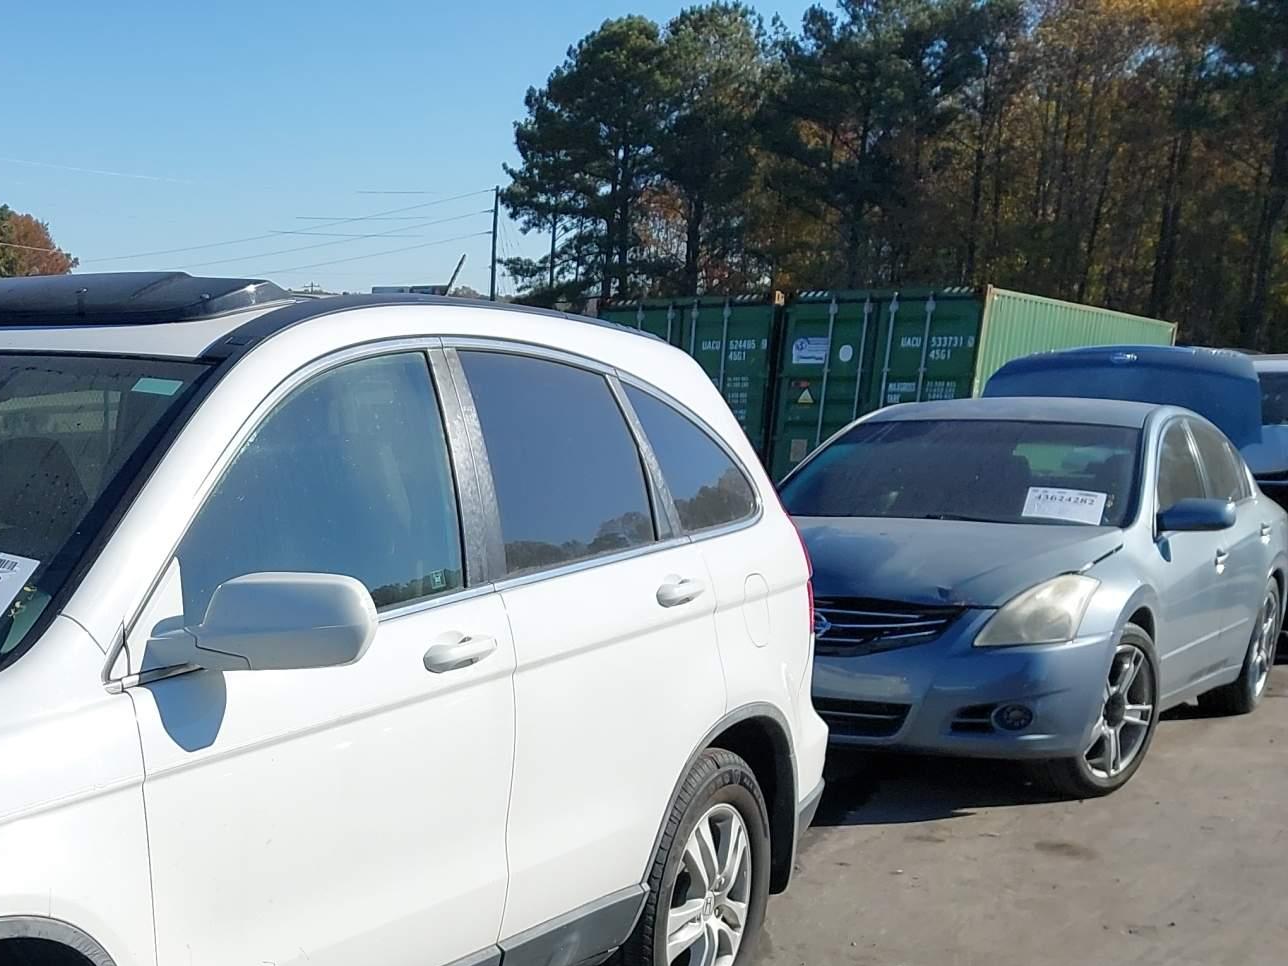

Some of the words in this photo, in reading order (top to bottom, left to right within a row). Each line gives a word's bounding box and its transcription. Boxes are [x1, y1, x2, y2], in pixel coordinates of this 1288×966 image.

[900, 336, 922, 348] UACU
[931, 336, 964, 348] 533731
[928, 349, 951, 360] 45G1
